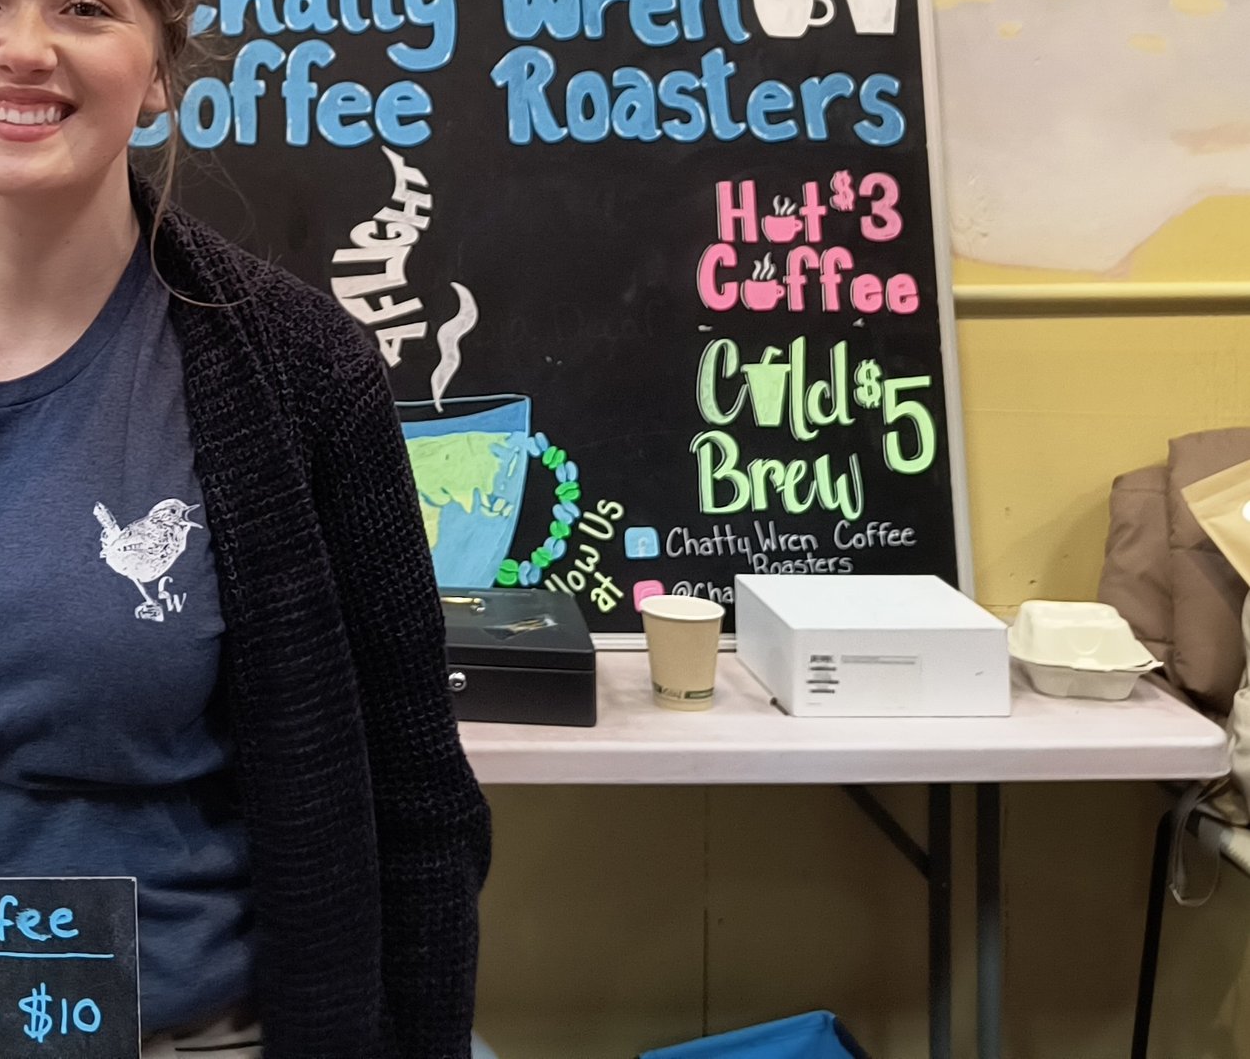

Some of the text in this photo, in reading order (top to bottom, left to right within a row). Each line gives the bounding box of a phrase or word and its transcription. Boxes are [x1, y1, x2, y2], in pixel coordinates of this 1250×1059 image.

[129, 38, 906, 149] offee Roasters
[688, 429, 865, 522] Brew
[665, 520, 918, 566] Chatty Wren Coffee
[752, 552, 855, 575] Roasters
[590, 572, 625, 614] at
[18, 981, 102, 1044] $10
